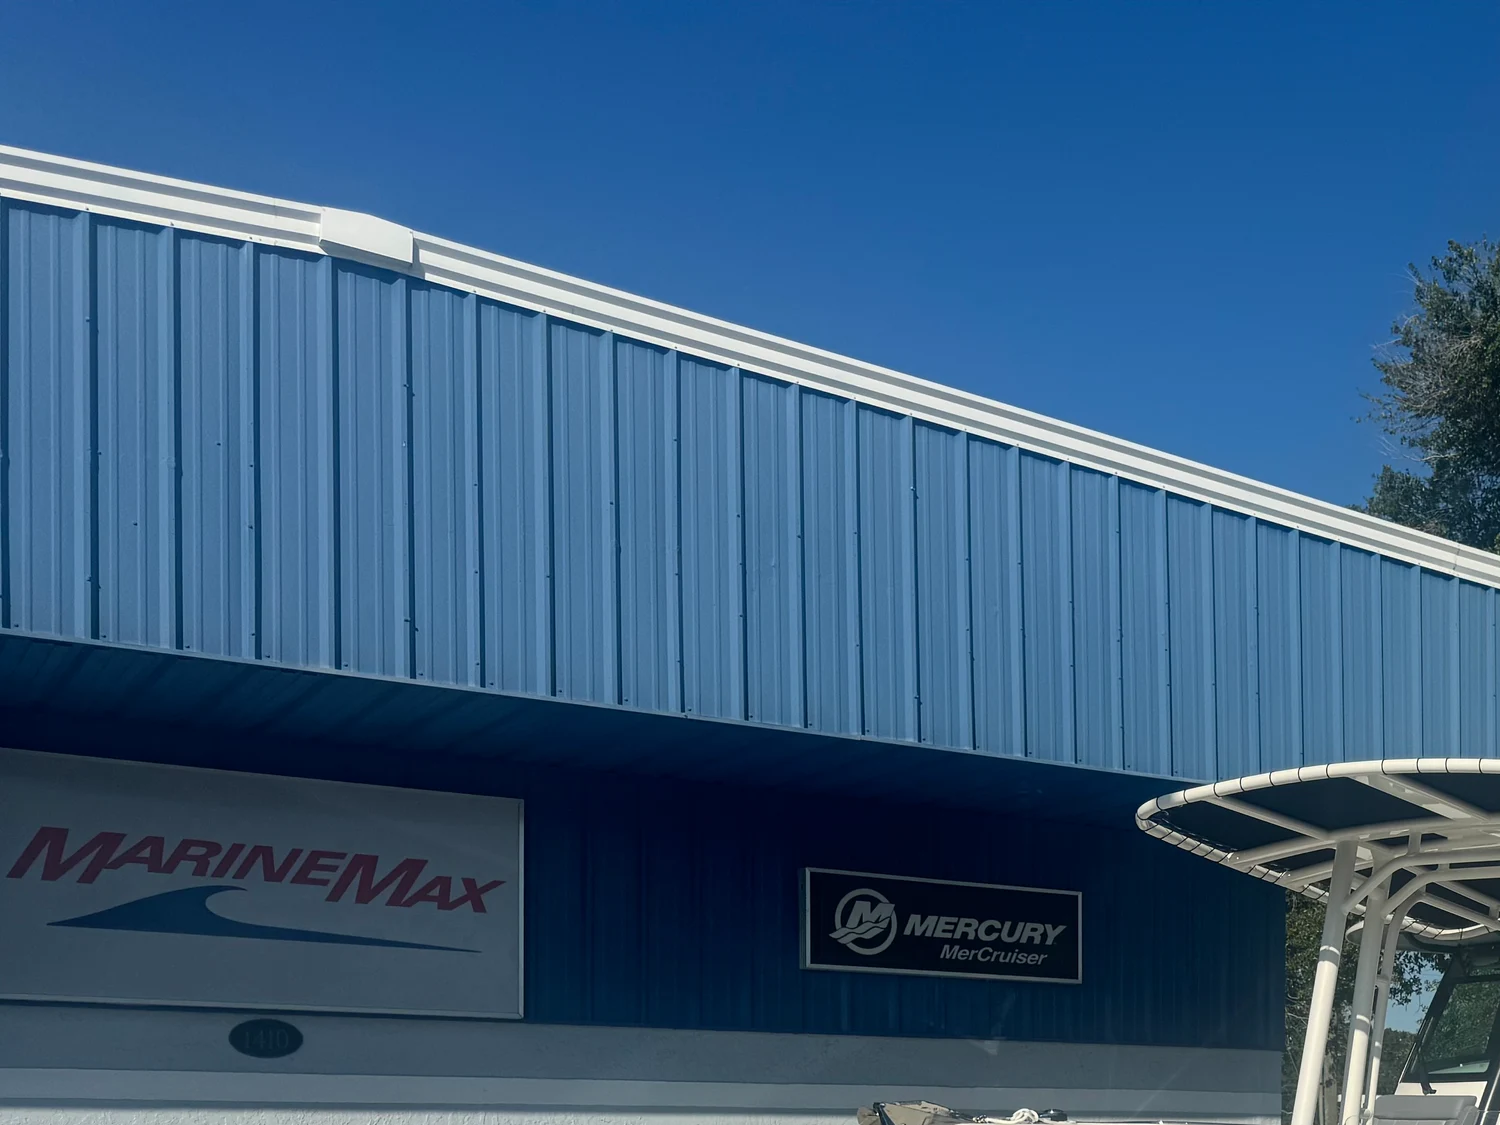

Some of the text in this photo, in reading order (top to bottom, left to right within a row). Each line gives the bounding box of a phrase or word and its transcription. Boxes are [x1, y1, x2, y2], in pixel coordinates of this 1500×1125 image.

[6, 826, 507, 914] MARINEMAX
[903, 914, 1067, 945] MERCURY
[940, 944, 1048, 965] MerCruiser
[244, 1029, 289, 1050] 1410
